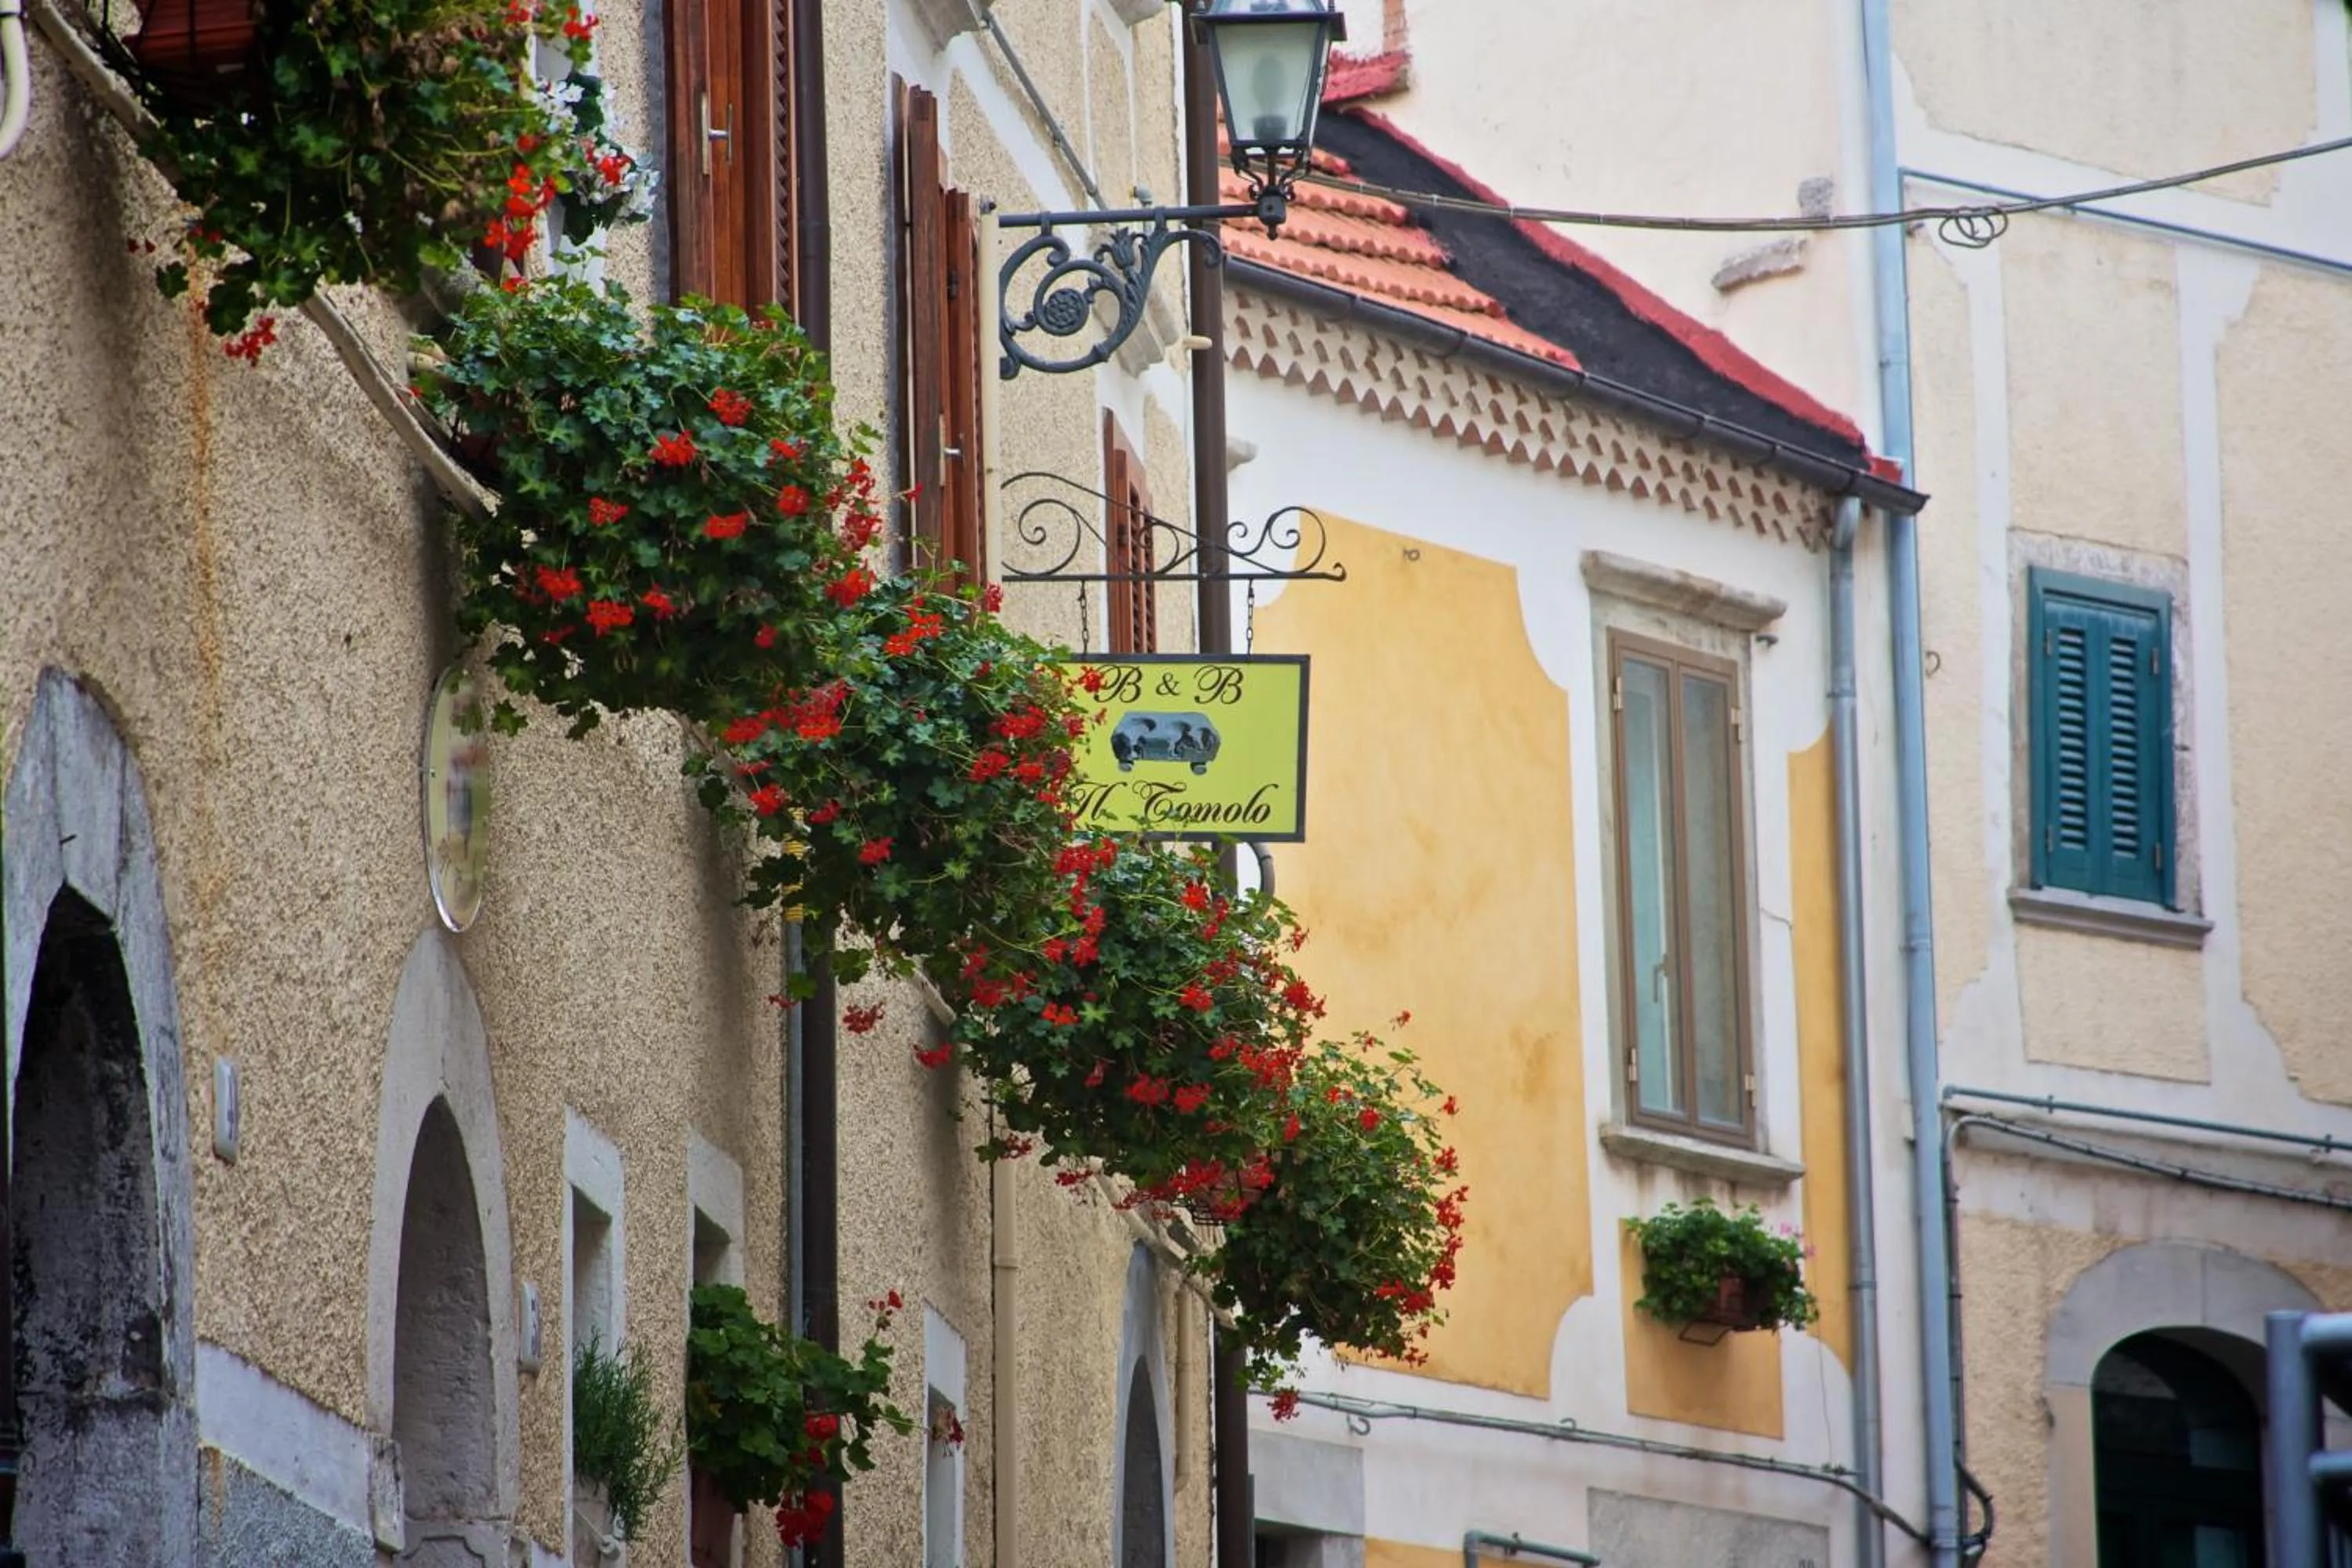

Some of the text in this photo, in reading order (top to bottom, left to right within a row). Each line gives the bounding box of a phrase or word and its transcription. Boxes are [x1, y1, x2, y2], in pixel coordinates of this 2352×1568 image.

[1093, 664, 1243, 705] B & B
[1131, 780, 1279, 824] Tomolo
